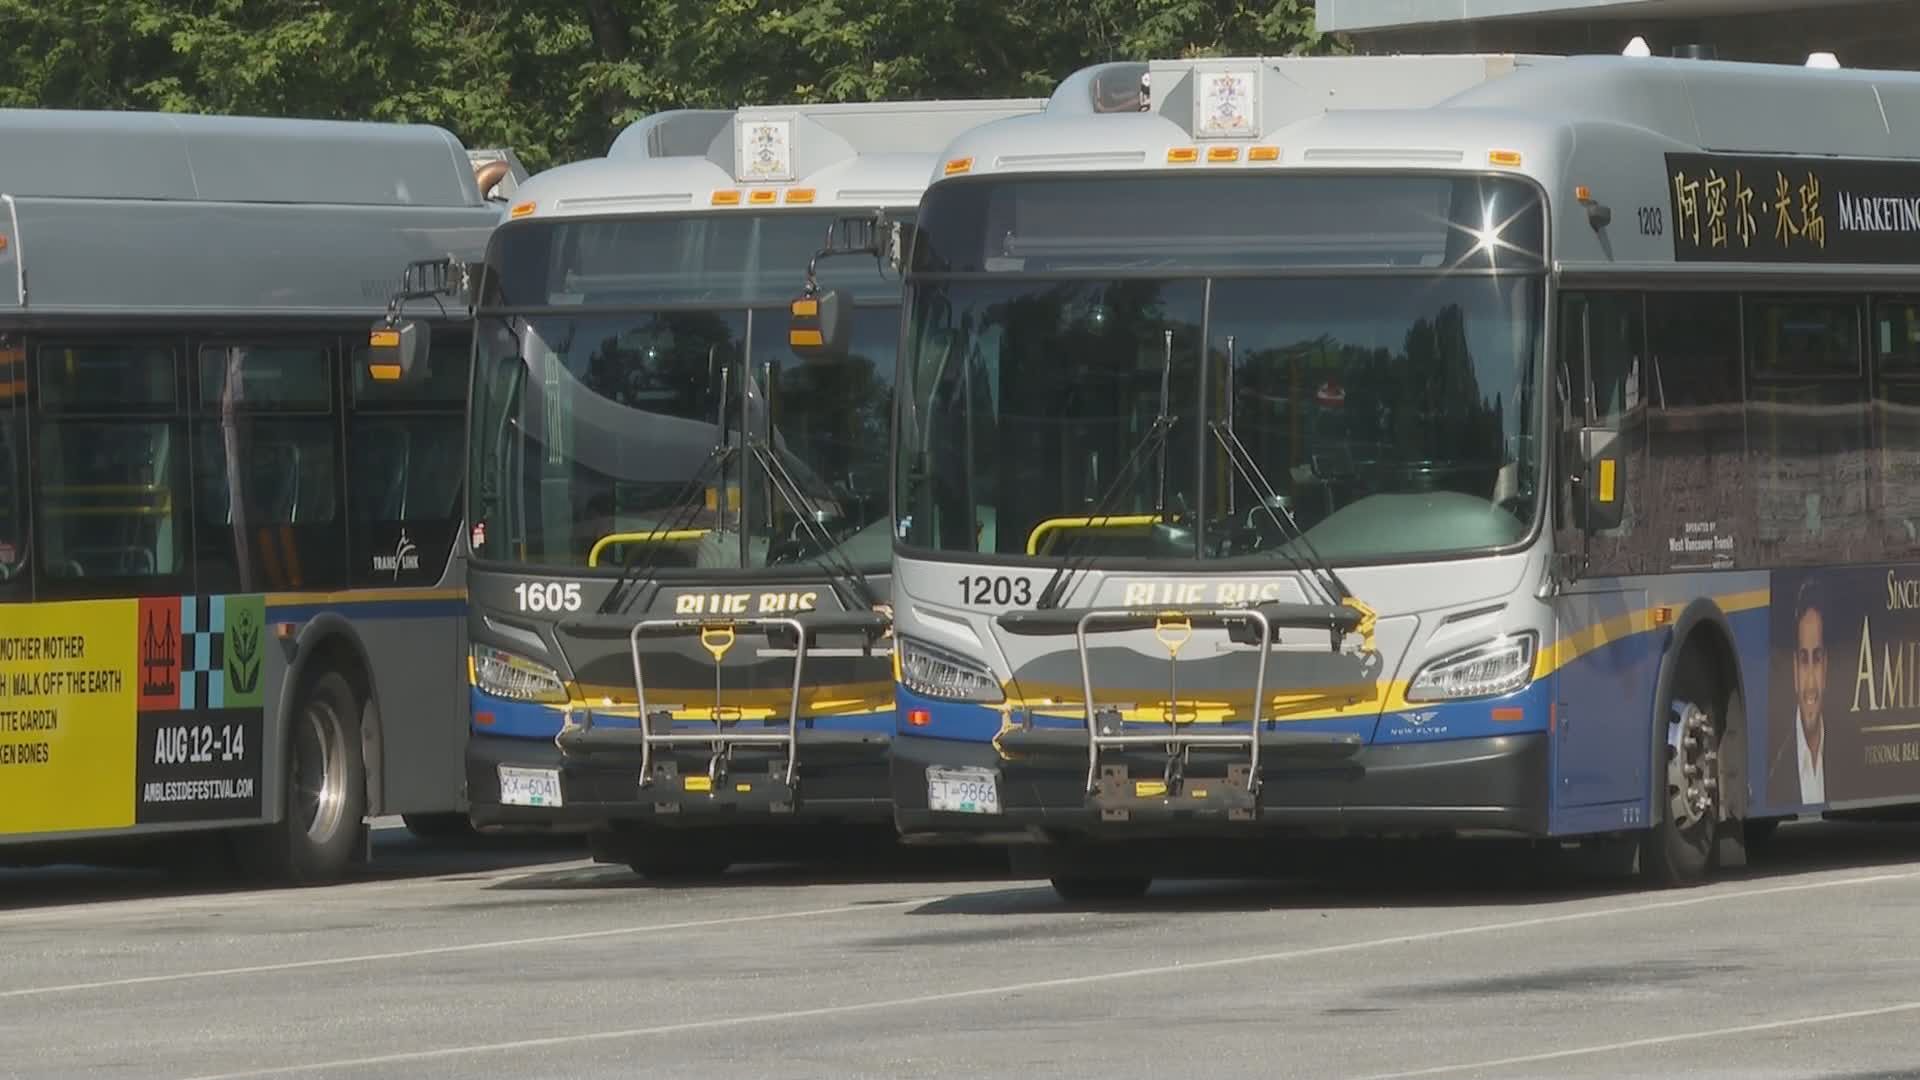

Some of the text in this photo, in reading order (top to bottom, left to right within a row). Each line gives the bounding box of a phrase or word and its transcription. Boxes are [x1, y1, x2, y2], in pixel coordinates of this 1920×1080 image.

[1637, 206, 1663, 236] 1203
[1674, 168, 1825, 248] 阿密尔·米瑞
[1668, 537, 1684, 552] West
[514, 582, 582, 612] 1605
[958, 575, 1032, 607] 1203
[1886, 569, 1920, 611] SINCE
[0, 635, 84, 661] MOTHER MOTHER
[1850, 615, 1920, 713] AMI
[13, 672, 41, 696] WALK
[42, 671, 63, 695] OFF
[66, 670, 86, 694] THE
[88, 669, 122, 693] EARTH
[20, 709, 57, 731] CARDIN
[17, 742, 49, 764] BONES
[155, 724, 245, 765] AUG 12-14
[143, 778, 254, 803] AMBLESIDEFESTIVAL.COM
